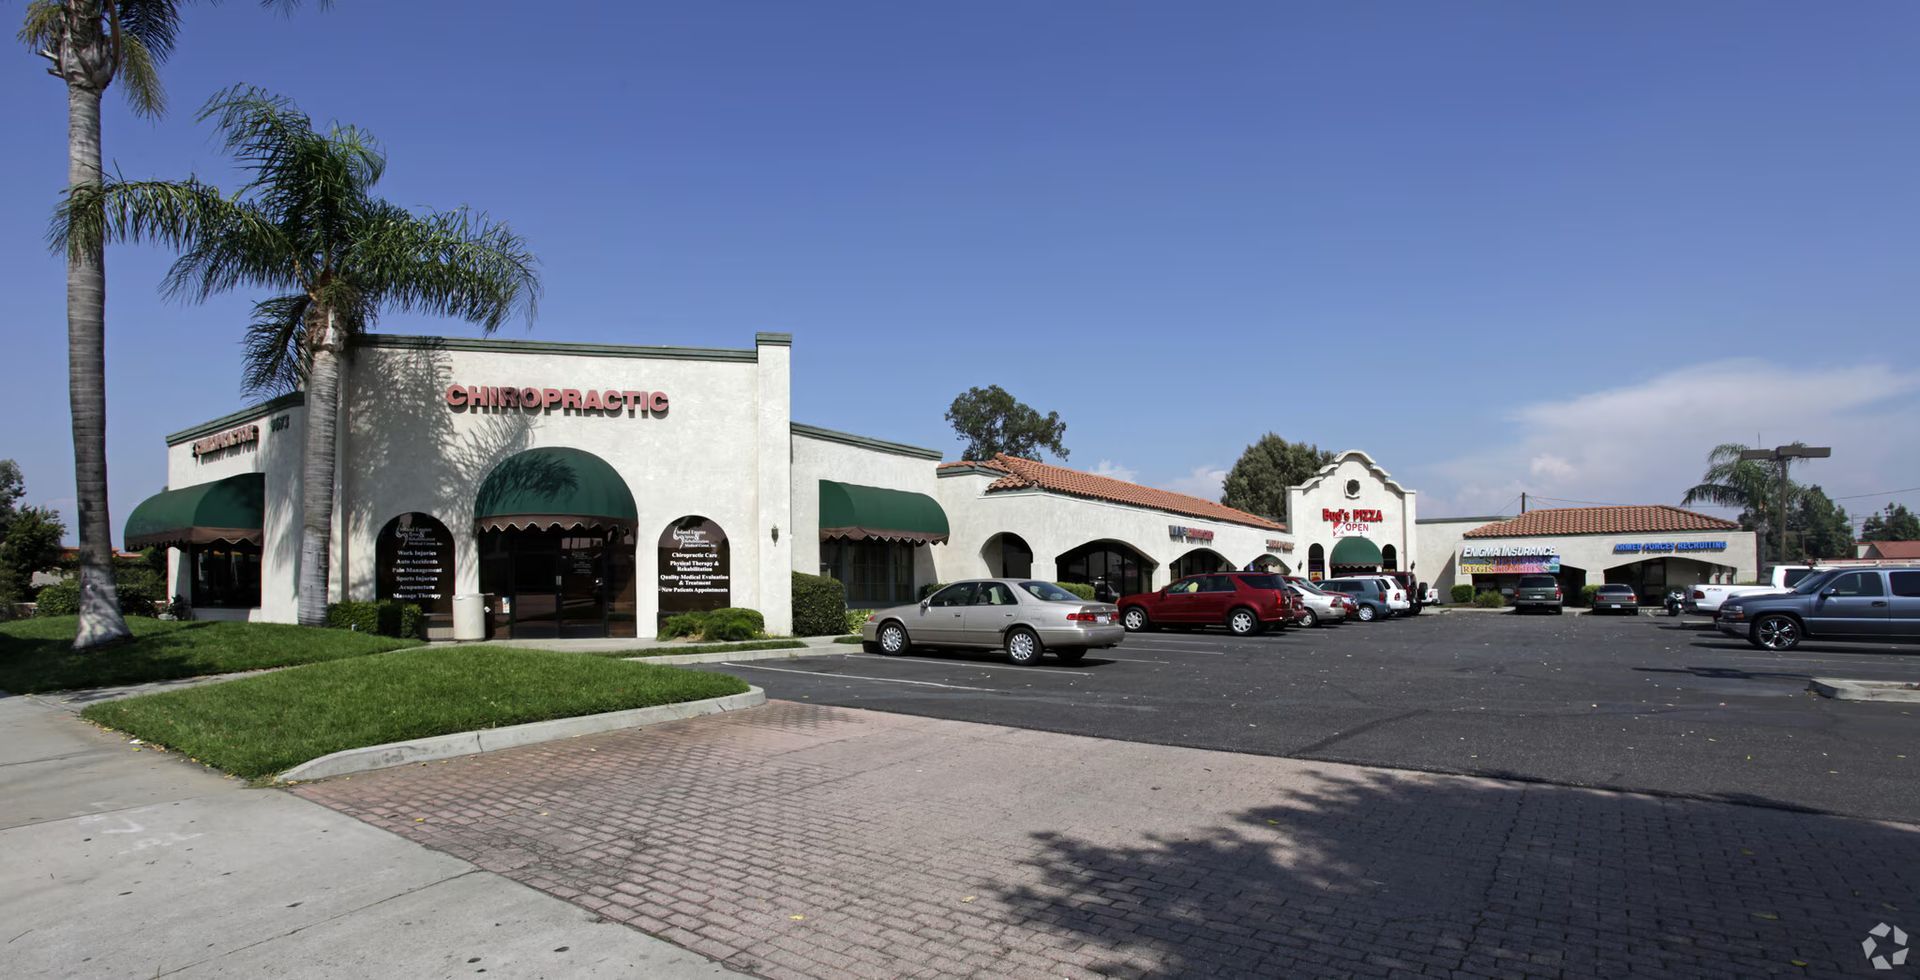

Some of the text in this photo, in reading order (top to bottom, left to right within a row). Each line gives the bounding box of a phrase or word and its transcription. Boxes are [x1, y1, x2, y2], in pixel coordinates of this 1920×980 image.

[446, 384, 669, 412] CHIROPRACTIC
[1353, 509, 1383, 523] PIZZA
[1345, 523, 1369, 532] OPEN
[1500, 544, 1556, 556] INSURANCE
[1614, 541, 1728, 552] ARMED FORCES RECRUITING
